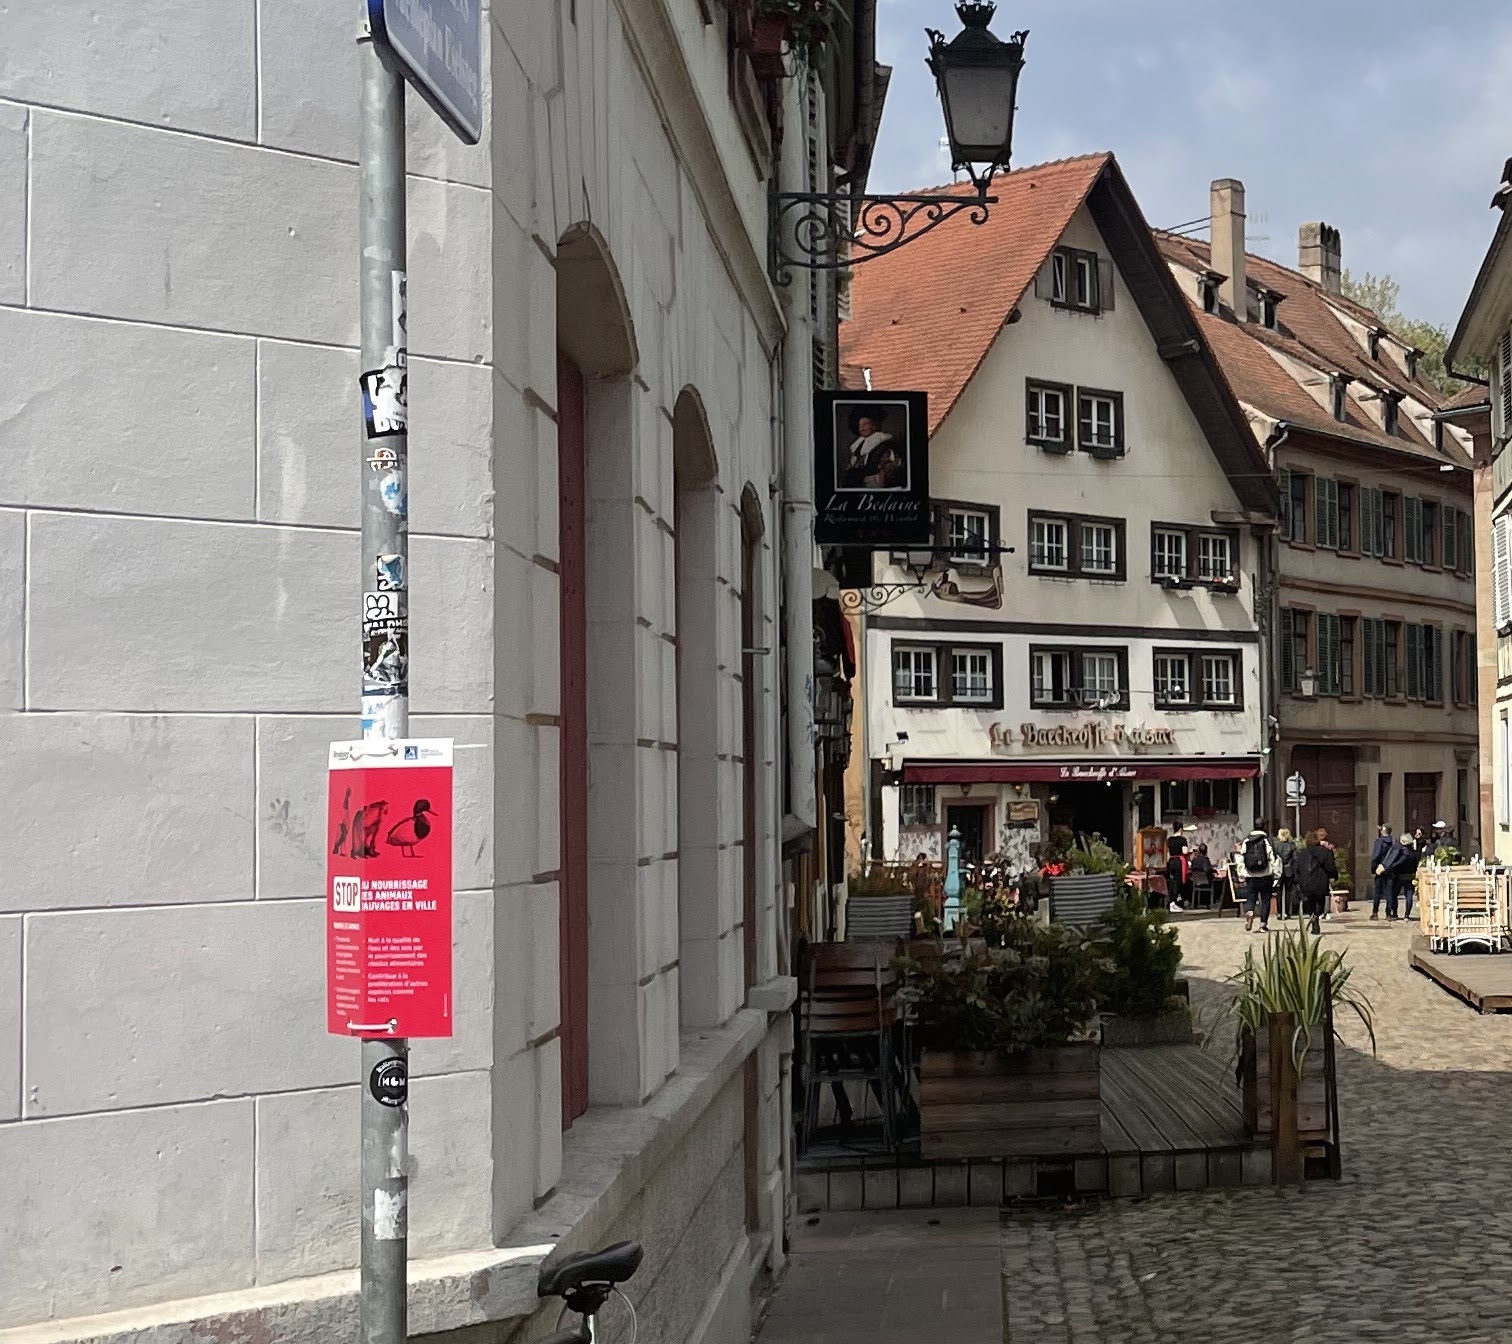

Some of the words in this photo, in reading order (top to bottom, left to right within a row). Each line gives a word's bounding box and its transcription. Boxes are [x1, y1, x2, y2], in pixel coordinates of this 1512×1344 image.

[825, 493, 849, 512] La
[857, 493, 921, 513] Bedaine
[371, 879, 428, 889] NOURRISSAGE
[335, 882, 358, 906] STOP
[375, 890, 413, 900] ANIMAUX
[402, 901, 413, 910] EN
[415, 900, 437, 910] VILLE
